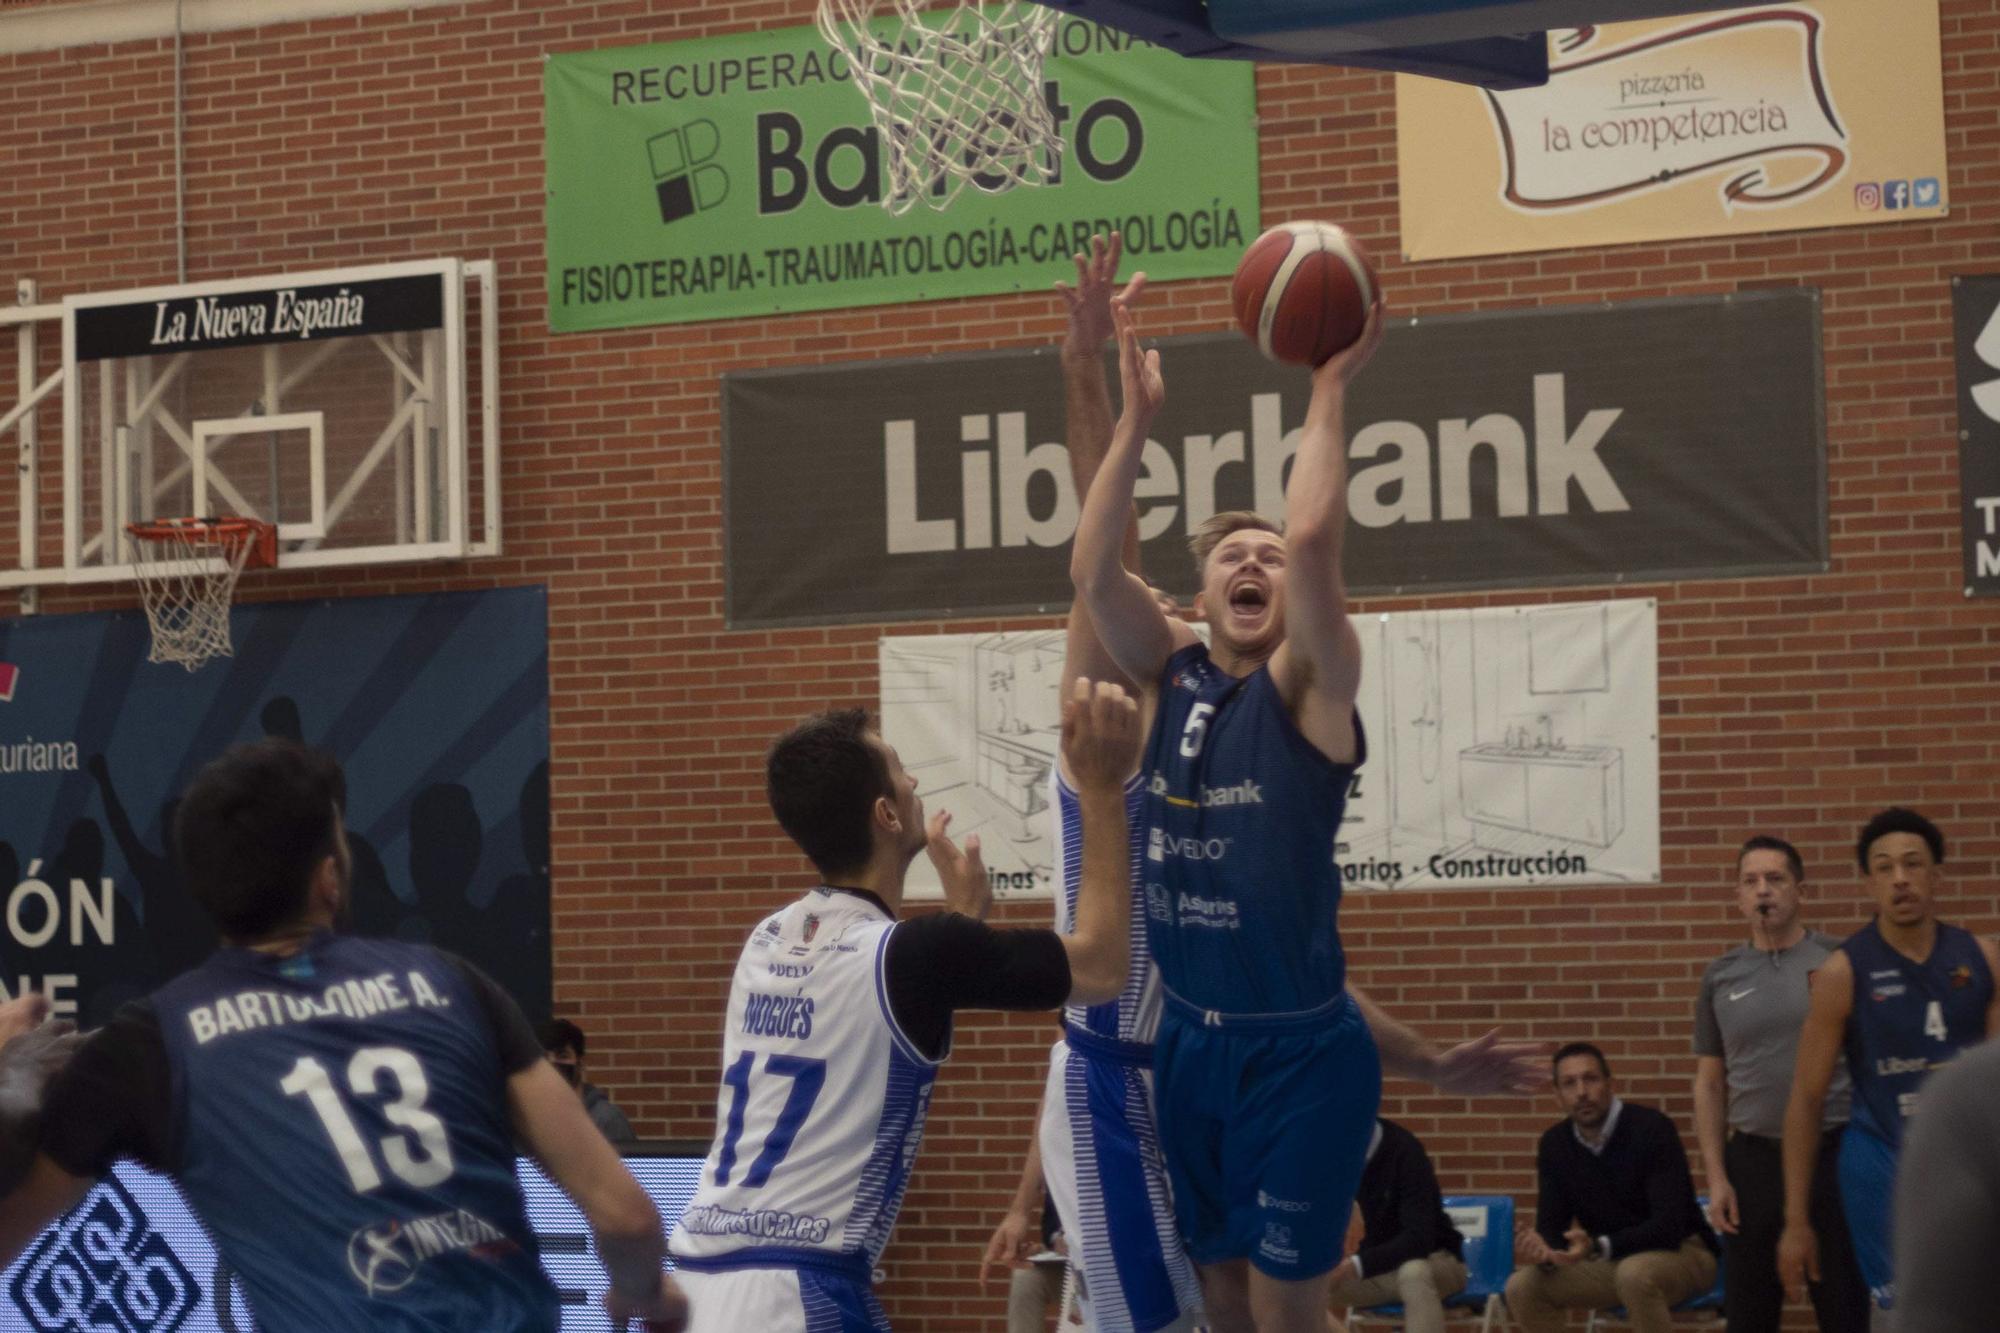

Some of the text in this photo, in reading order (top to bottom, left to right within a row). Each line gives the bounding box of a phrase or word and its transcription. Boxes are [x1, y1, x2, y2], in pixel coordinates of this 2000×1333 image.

[939, 20, 1155, 69] FUNION
[1620, 67, 1706, 103] pizzería
[757, 81, 1144, 215] Barreto
[1543, 99, 1788, 152] la competencia
[151, 287, 364, 345] La Nueva España
[884, 372, 1632, 555] Liberbank
[0, 736, 79, 774] turiana
[1179, 702, 1217, 758] 5
[986, 866, 1036, 891] inas
[1340, 850, 1587, 883] arios Construcción
[742, 987, 815, 1041] NOGUÉS
[1924, 1001, 1949, 1042] 4
[279, 1047, 455, 1194] 13
[714, 1049, 828, 1189] 17
